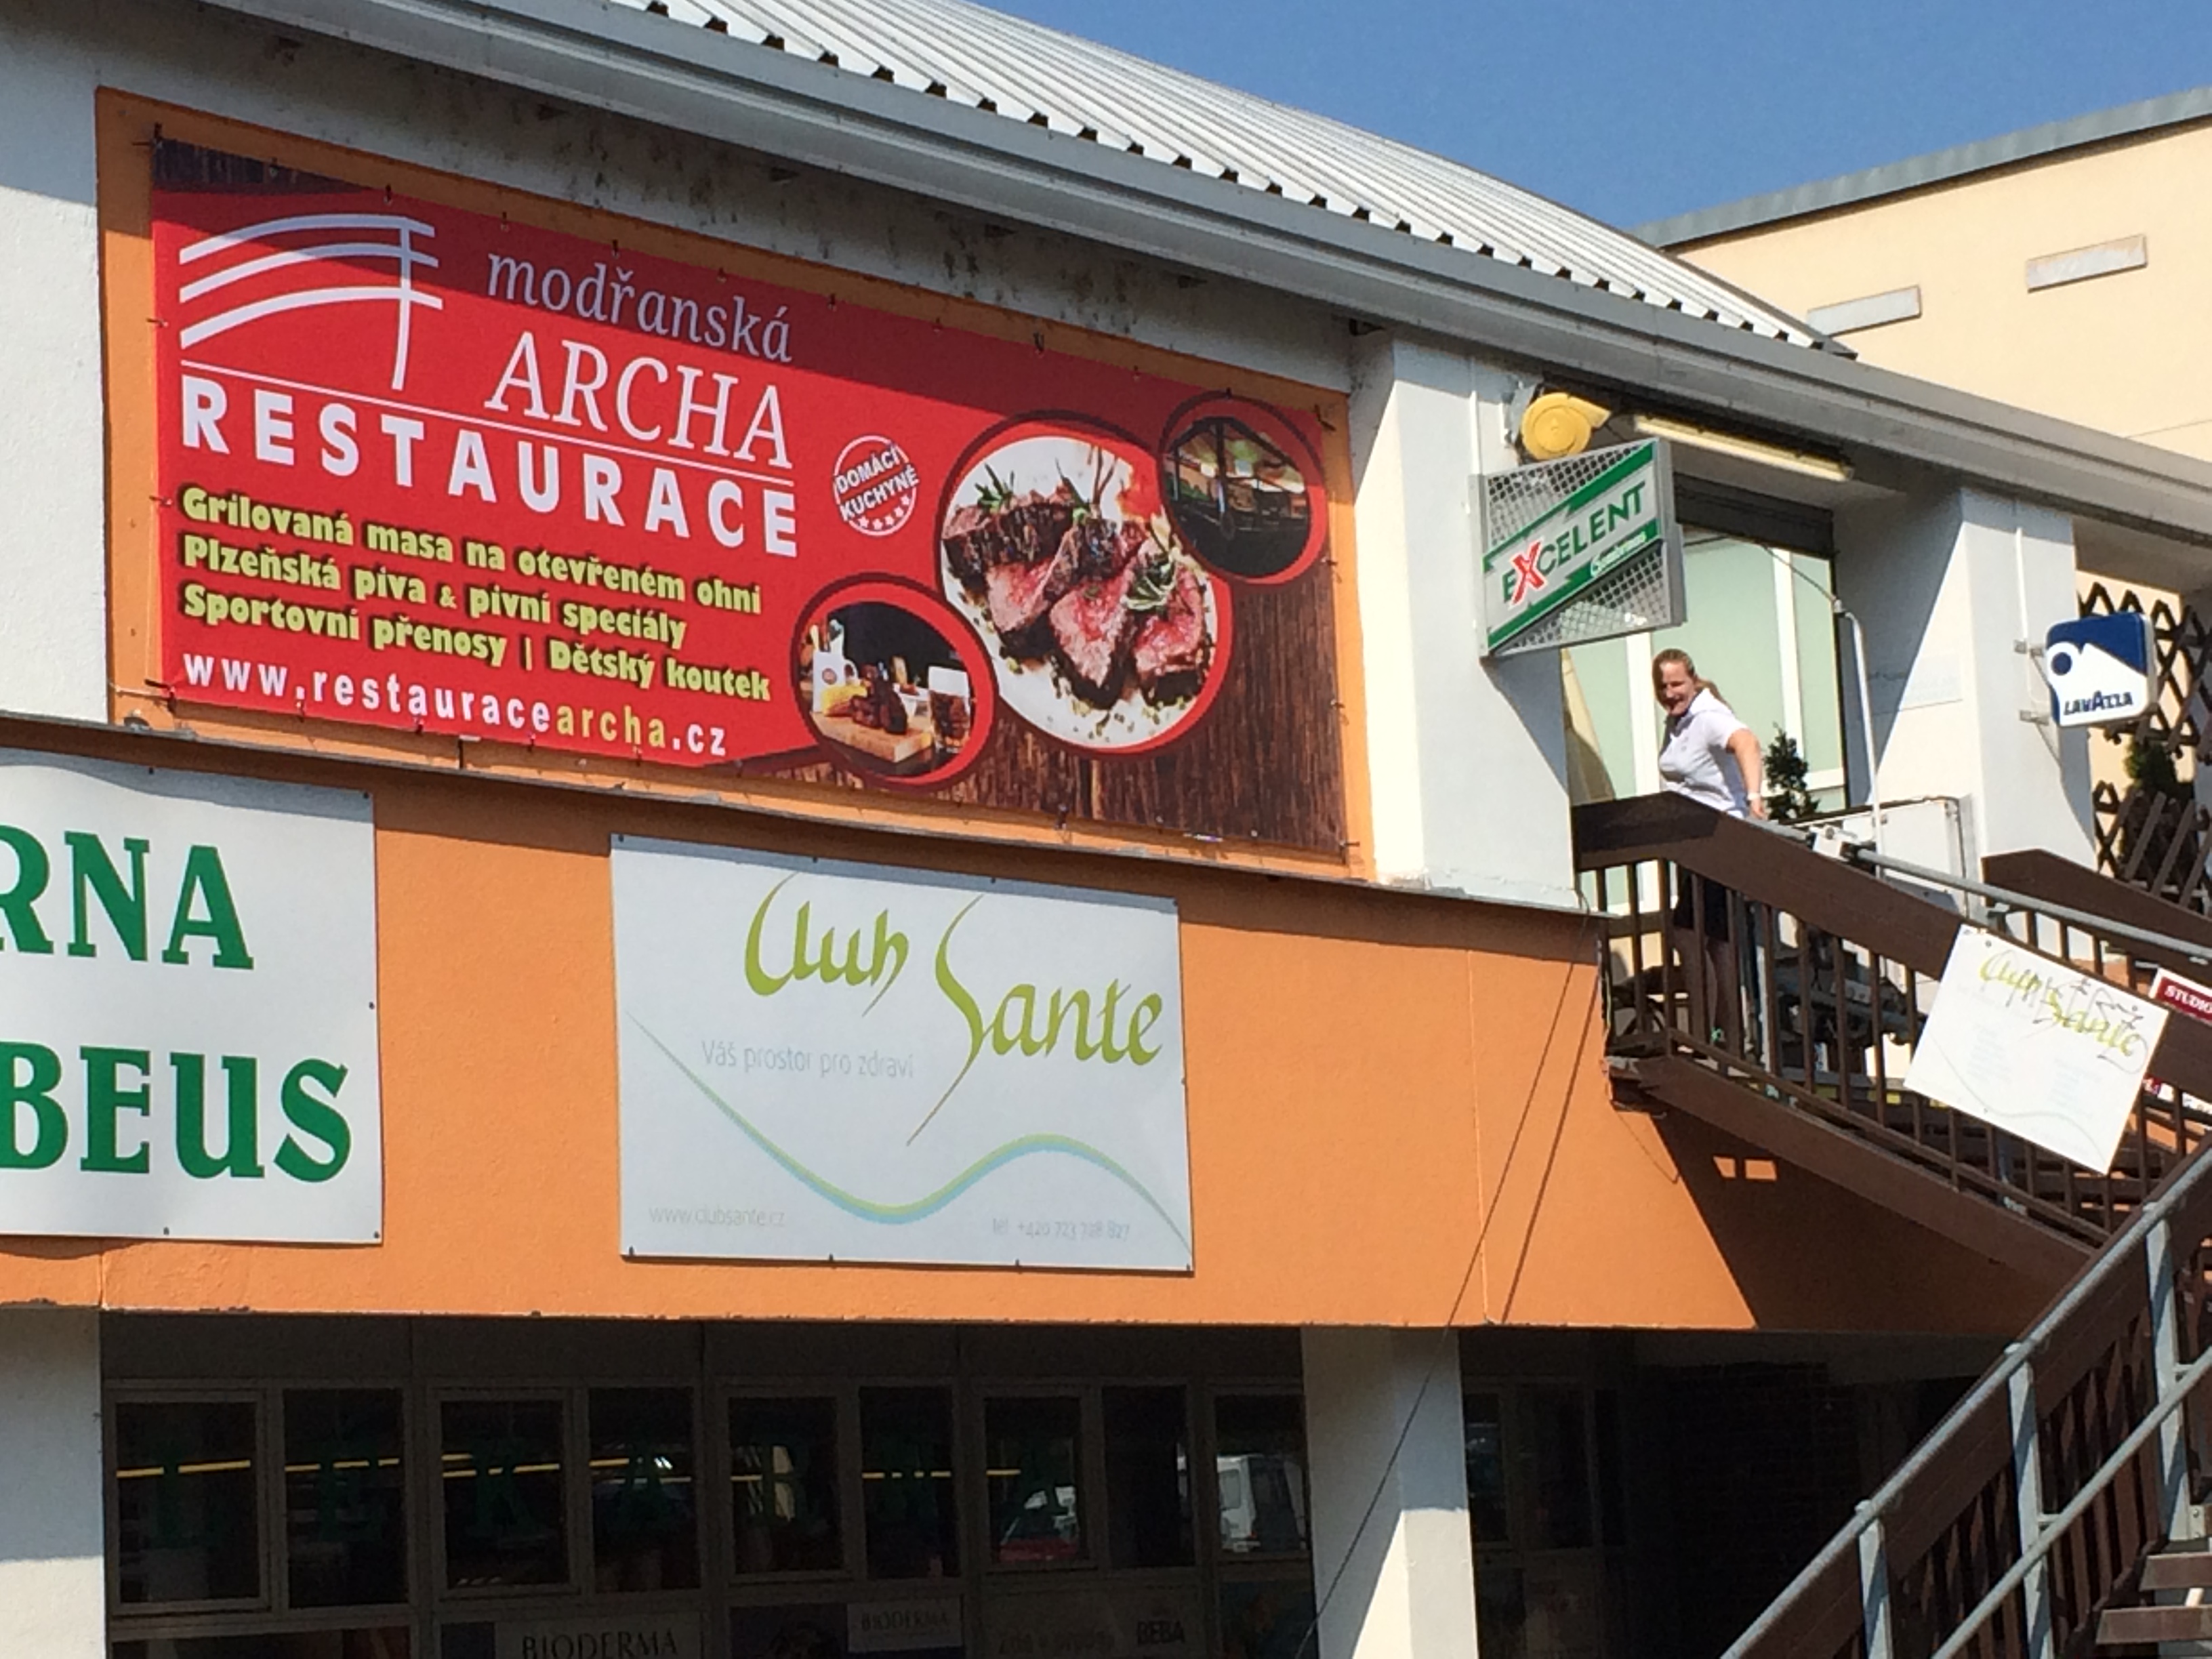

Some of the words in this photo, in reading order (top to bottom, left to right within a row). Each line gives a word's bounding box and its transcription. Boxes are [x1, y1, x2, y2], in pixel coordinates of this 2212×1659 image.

[489, 253, 793, 362] modřanská
[484, 331, 794, 470] ARCHA
[182, 374, 798, 558] RESTAURACE
[182, 487, 354, 546] Grilovaná
[367, 523, 453, 562] masa
[466, 540, 506, 571] na
[518, 548, 686, 602] otevřeném
[183, 534, 341, 590] Plzeňská
[354, 566, 427, 600] piva
[440, 585, 457, 609] &
[469, 583, 551, 623] pivní
[562, 600, 687, 650] speciály
[1502, 480, 1646, 605] EXCELENT
[184, 583, 360, 640] Sportovní
[373, 616, 508, 668] přenosy
[549, 640, 655, 690] Dětský
[666, 657, 771, 701] koutek
[183, 653, 726, 757] www.restauracearcha.cz
[701, 1039, 737, 1067] Váš
[744, 1046, 813, 1073] prostor
[820, 1052, 852, 1078] pro
[859, 1048, 914, 1079] zdraví
